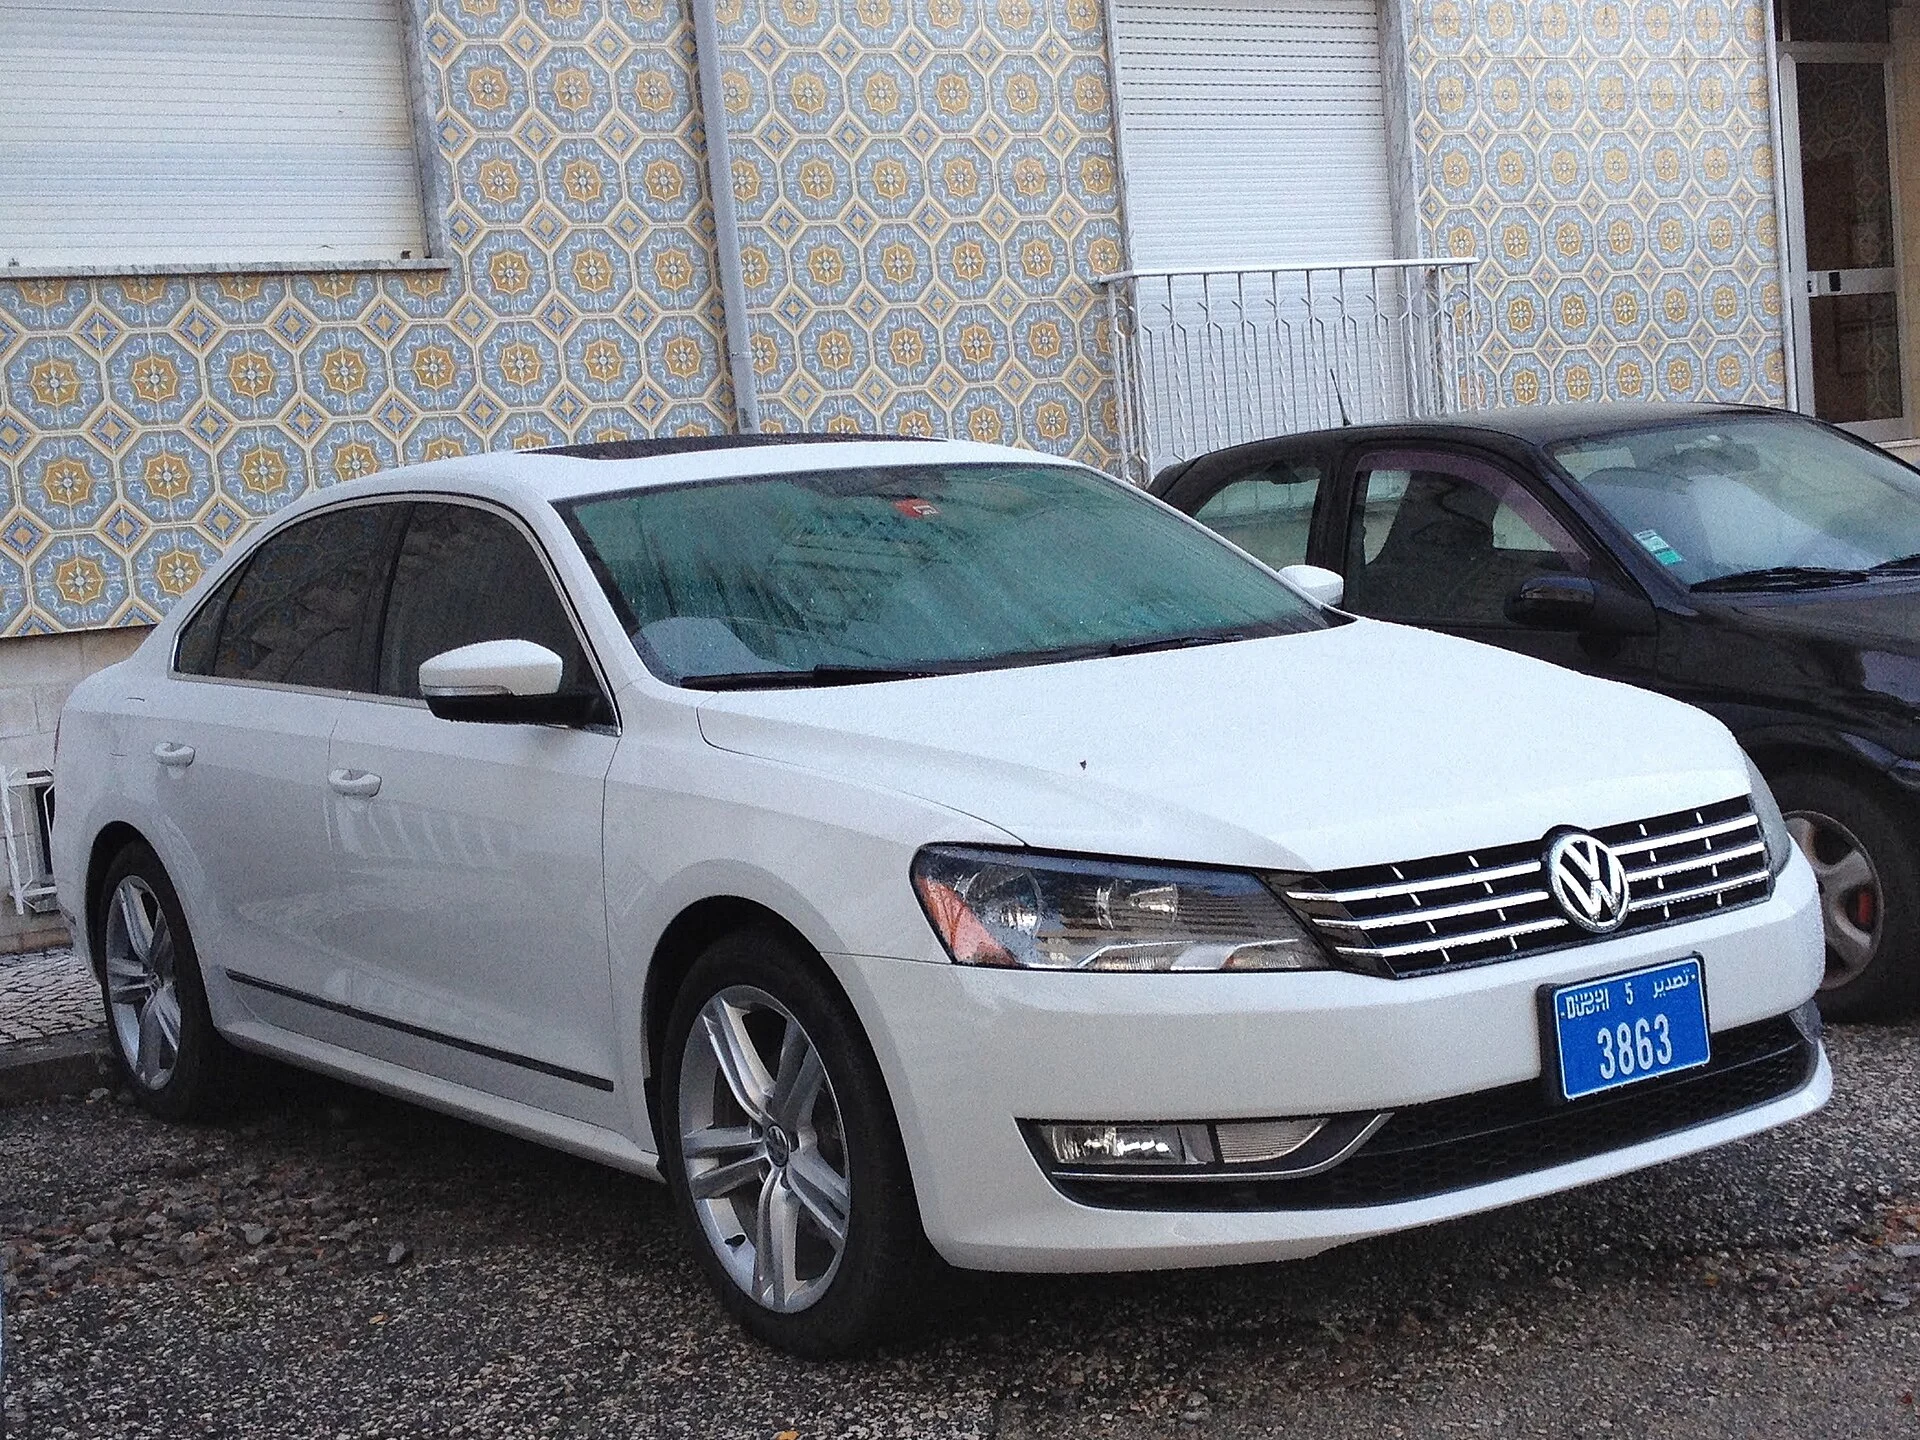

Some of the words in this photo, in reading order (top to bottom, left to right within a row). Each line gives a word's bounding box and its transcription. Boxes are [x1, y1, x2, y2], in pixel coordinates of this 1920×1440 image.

[1552, 834, 1629, 932] VW
[1624, 981, 1634, 1005] 5
[1653, 968, 1689, 998] تصدير
[1597, 1013, 1672, 1080] 3863
